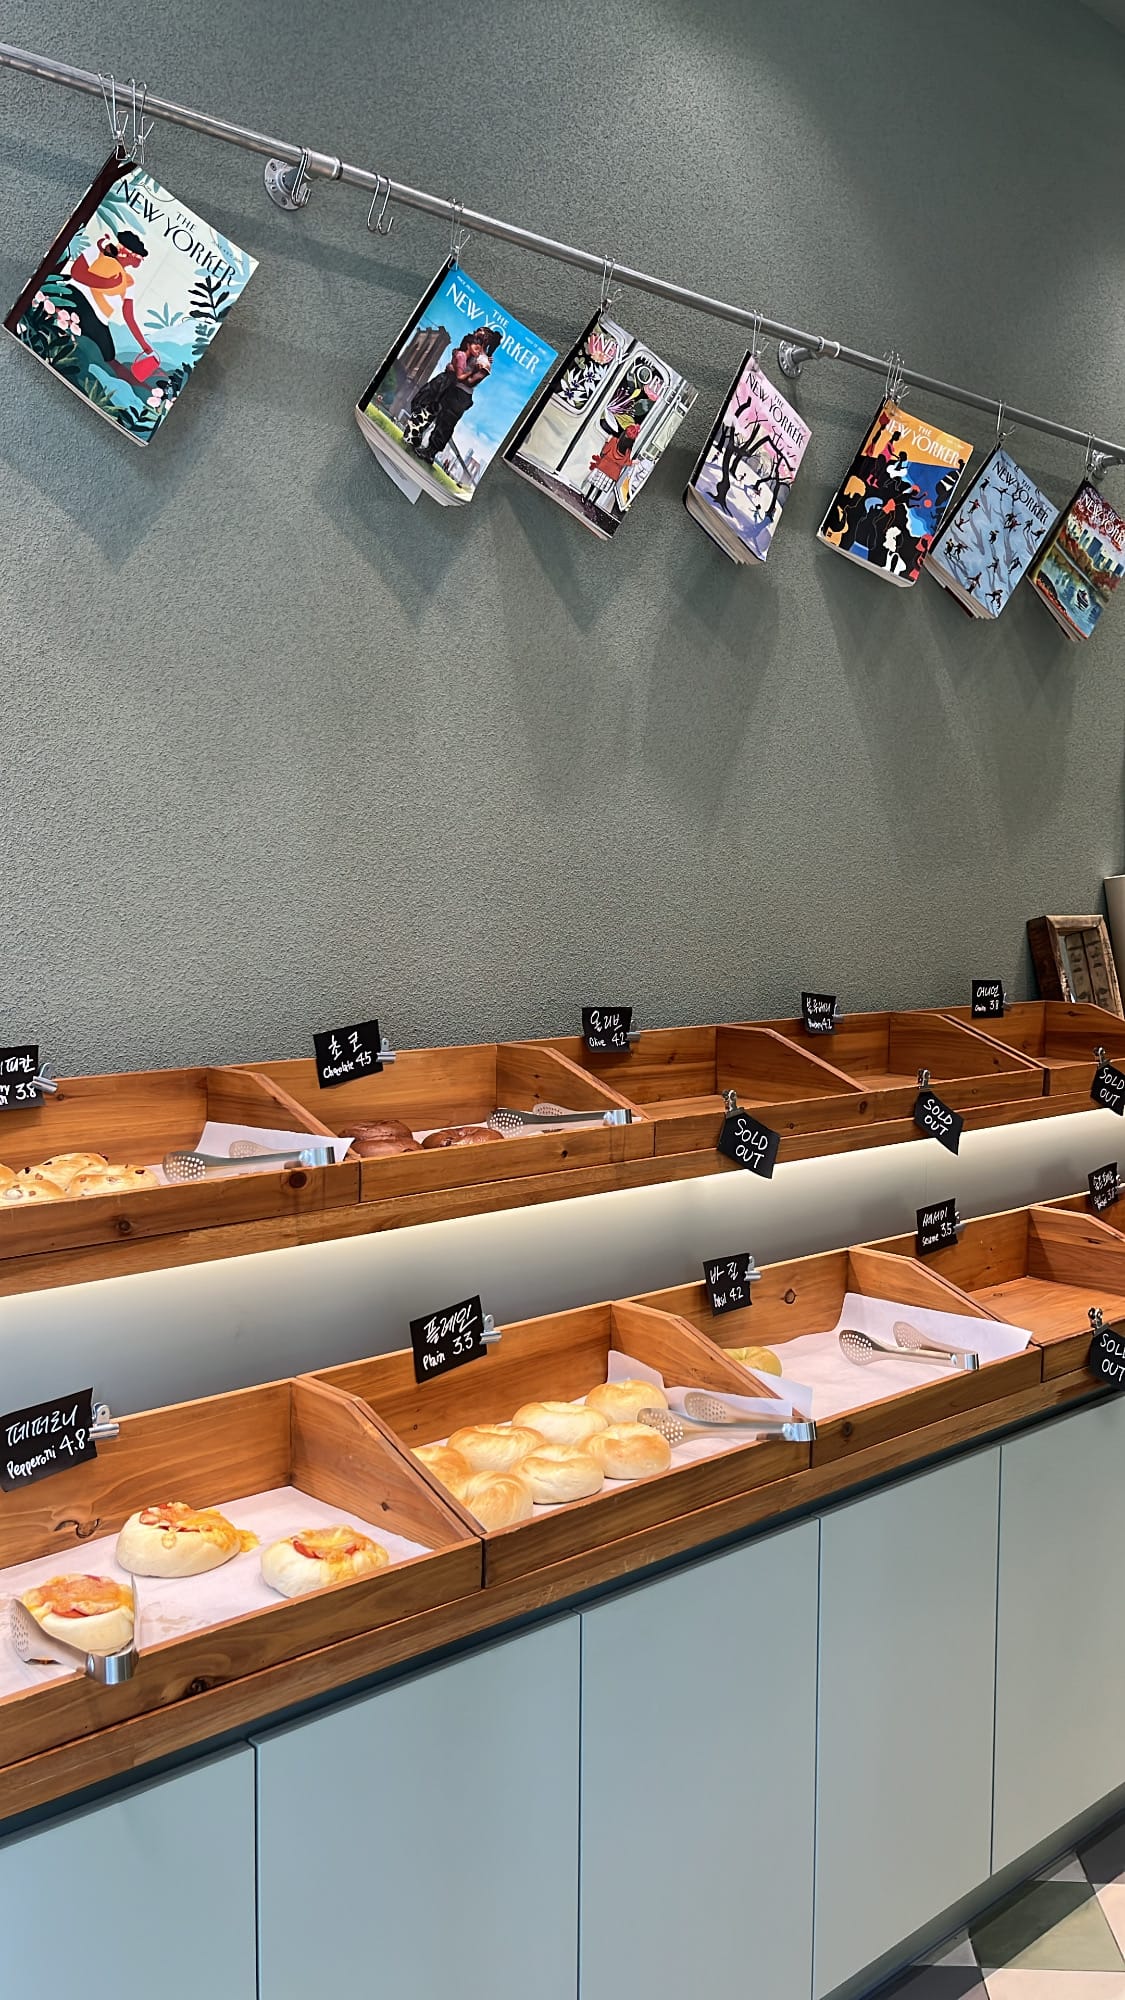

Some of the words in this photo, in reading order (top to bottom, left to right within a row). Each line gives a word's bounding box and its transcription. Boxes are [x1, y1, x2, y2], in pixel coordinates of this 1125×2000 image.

[117, 179, 165, 223] NEW
[163, 217, 236, 287] YORKER
[176, 212, 197, 233] THE
[446, 282, 485, 320] NEW
[484, 314, 540, 374] YORKER
[492, 309, 510, 329] THE
[593, 333, 632, 365] NEW
[631, 360, 682, 409] YORKER
[746, 373, 770, 402] NEW
[769, 398, 805, 448] YORKER
[918, 425, 933, 437] THE
[911, 430, 960, 467] YORKER
[992, 461, 1018, 487] NEW
[1014, 482, 1049, 525] YORKER
[611, 1031, 627, 1047] 4.2
[355, 1050, 372, 1067] 4.5
[1099, 1067, 1125, 1090] SOLD
[15, 1082, 37, 1100] 3.8
[1100, 1088, 1121, 1107] OUT
[923, 1098, 953, 1125] SOLD
[734, 1118, 768, 1151] SOLD
[924, 1114, 949, 1136] OUT
[735, 1144, 765, 1169] OUT
[940, 1222, 952, 1238] 3.5
[709, 1262, 739, 1285] 바질
[729, 1286, 744, 1301] 4.2
[422, 1350, 446, 1371] Plain
[452, 1330, 474, 1355] 3.3
[1101, 1358, 1125, 1382] OUT
[7, 1445, 57, 1480] Pepperoni
[59, 1428, 86, 1456] 4.8
